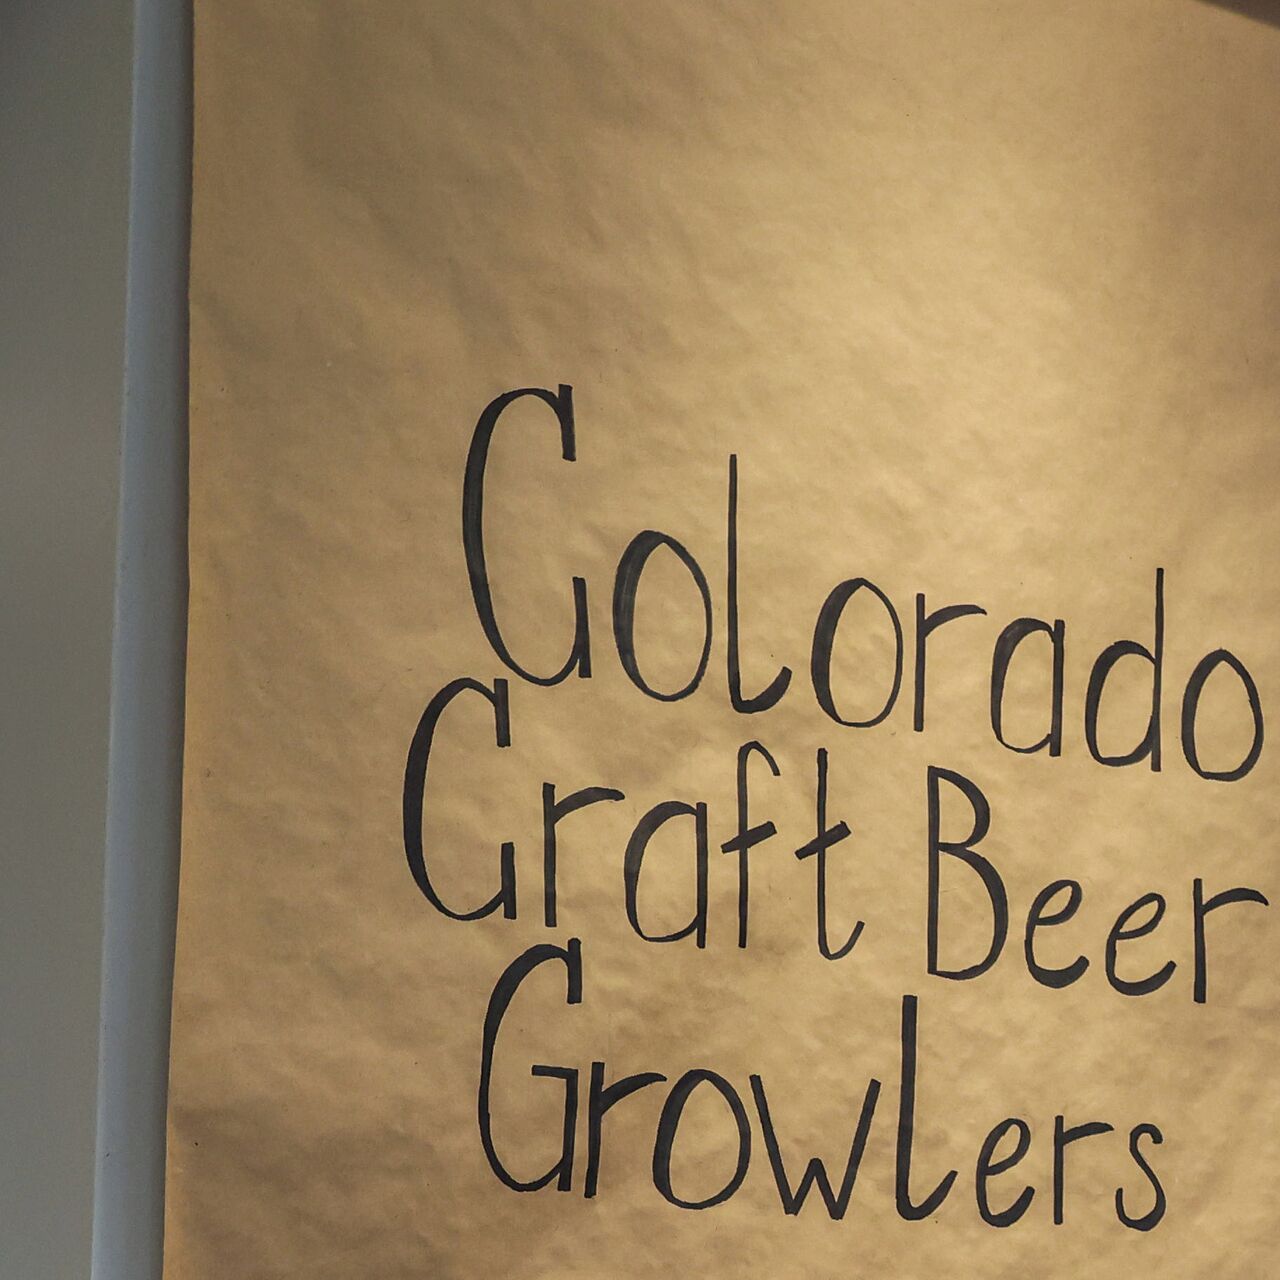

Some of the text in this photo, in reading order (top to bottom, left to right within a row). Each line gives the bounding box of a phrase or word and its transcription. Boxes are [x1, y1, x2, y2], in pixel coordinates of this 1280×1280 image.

[462, 384, 1263, 781] Colorado
[403, 678, 1269, 1004] Craft Beer
[477, 939, 1166, 1231] Growlers
